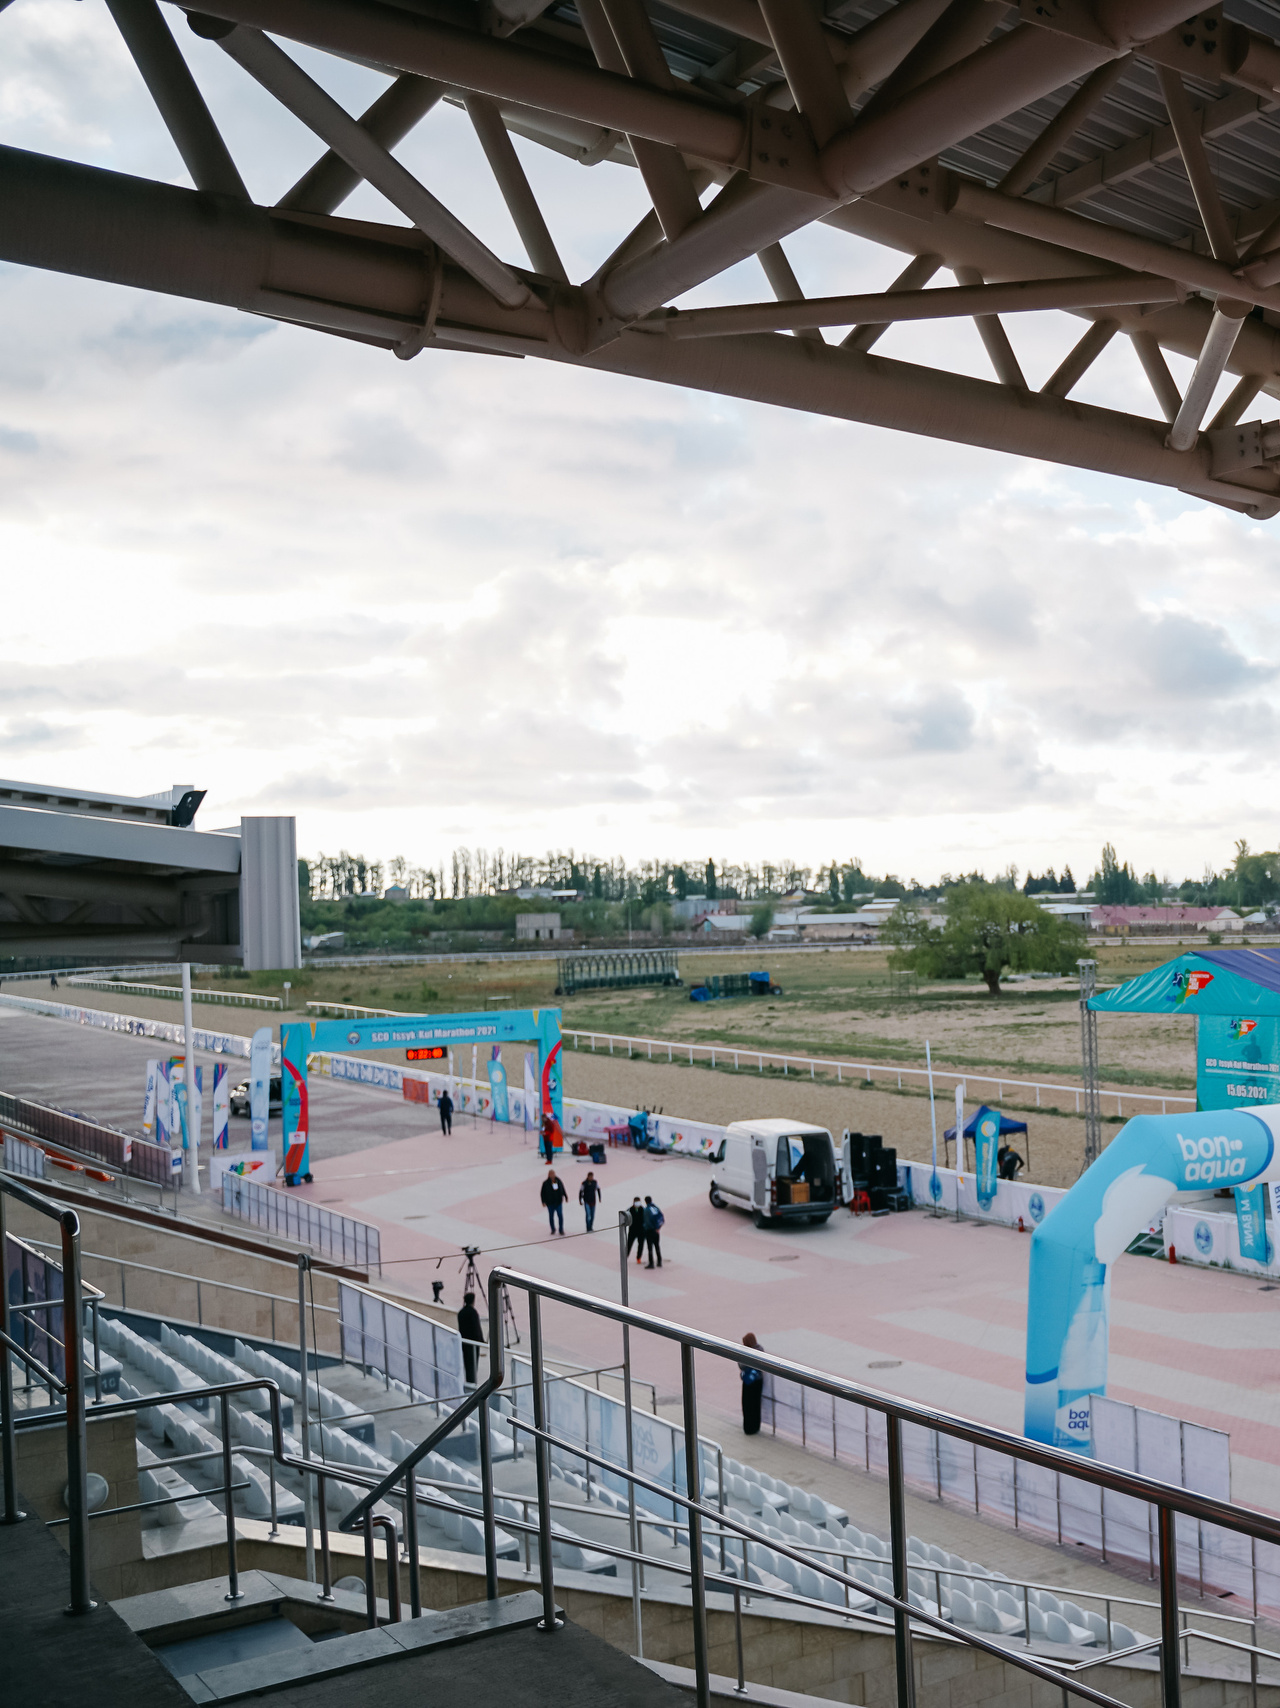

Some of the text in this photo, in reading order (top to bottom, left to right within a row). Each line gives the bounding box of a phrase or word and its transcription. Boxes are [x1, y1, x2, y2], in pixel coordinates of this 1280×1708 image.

[371, 1032, 390, 1043] SCO
[433, 1027, 476, 1039] Marathon
[476, 1025, 497, 1036] 2021
[1205, 1058, 1217, 1068] SCO
[1241, 1061, 1269, 1072] Marathon
[1269, 1063, 1280, 1073] 2021
[1226, 1084, 1268, 1099] 15.05.2021
[1176, 1133, 1232, 1162] bon
[1184, 1157, 1247, 1184] aqua
[101, 1377, 116, 1389] 10
[358, 1428, 366, 1439] 7
